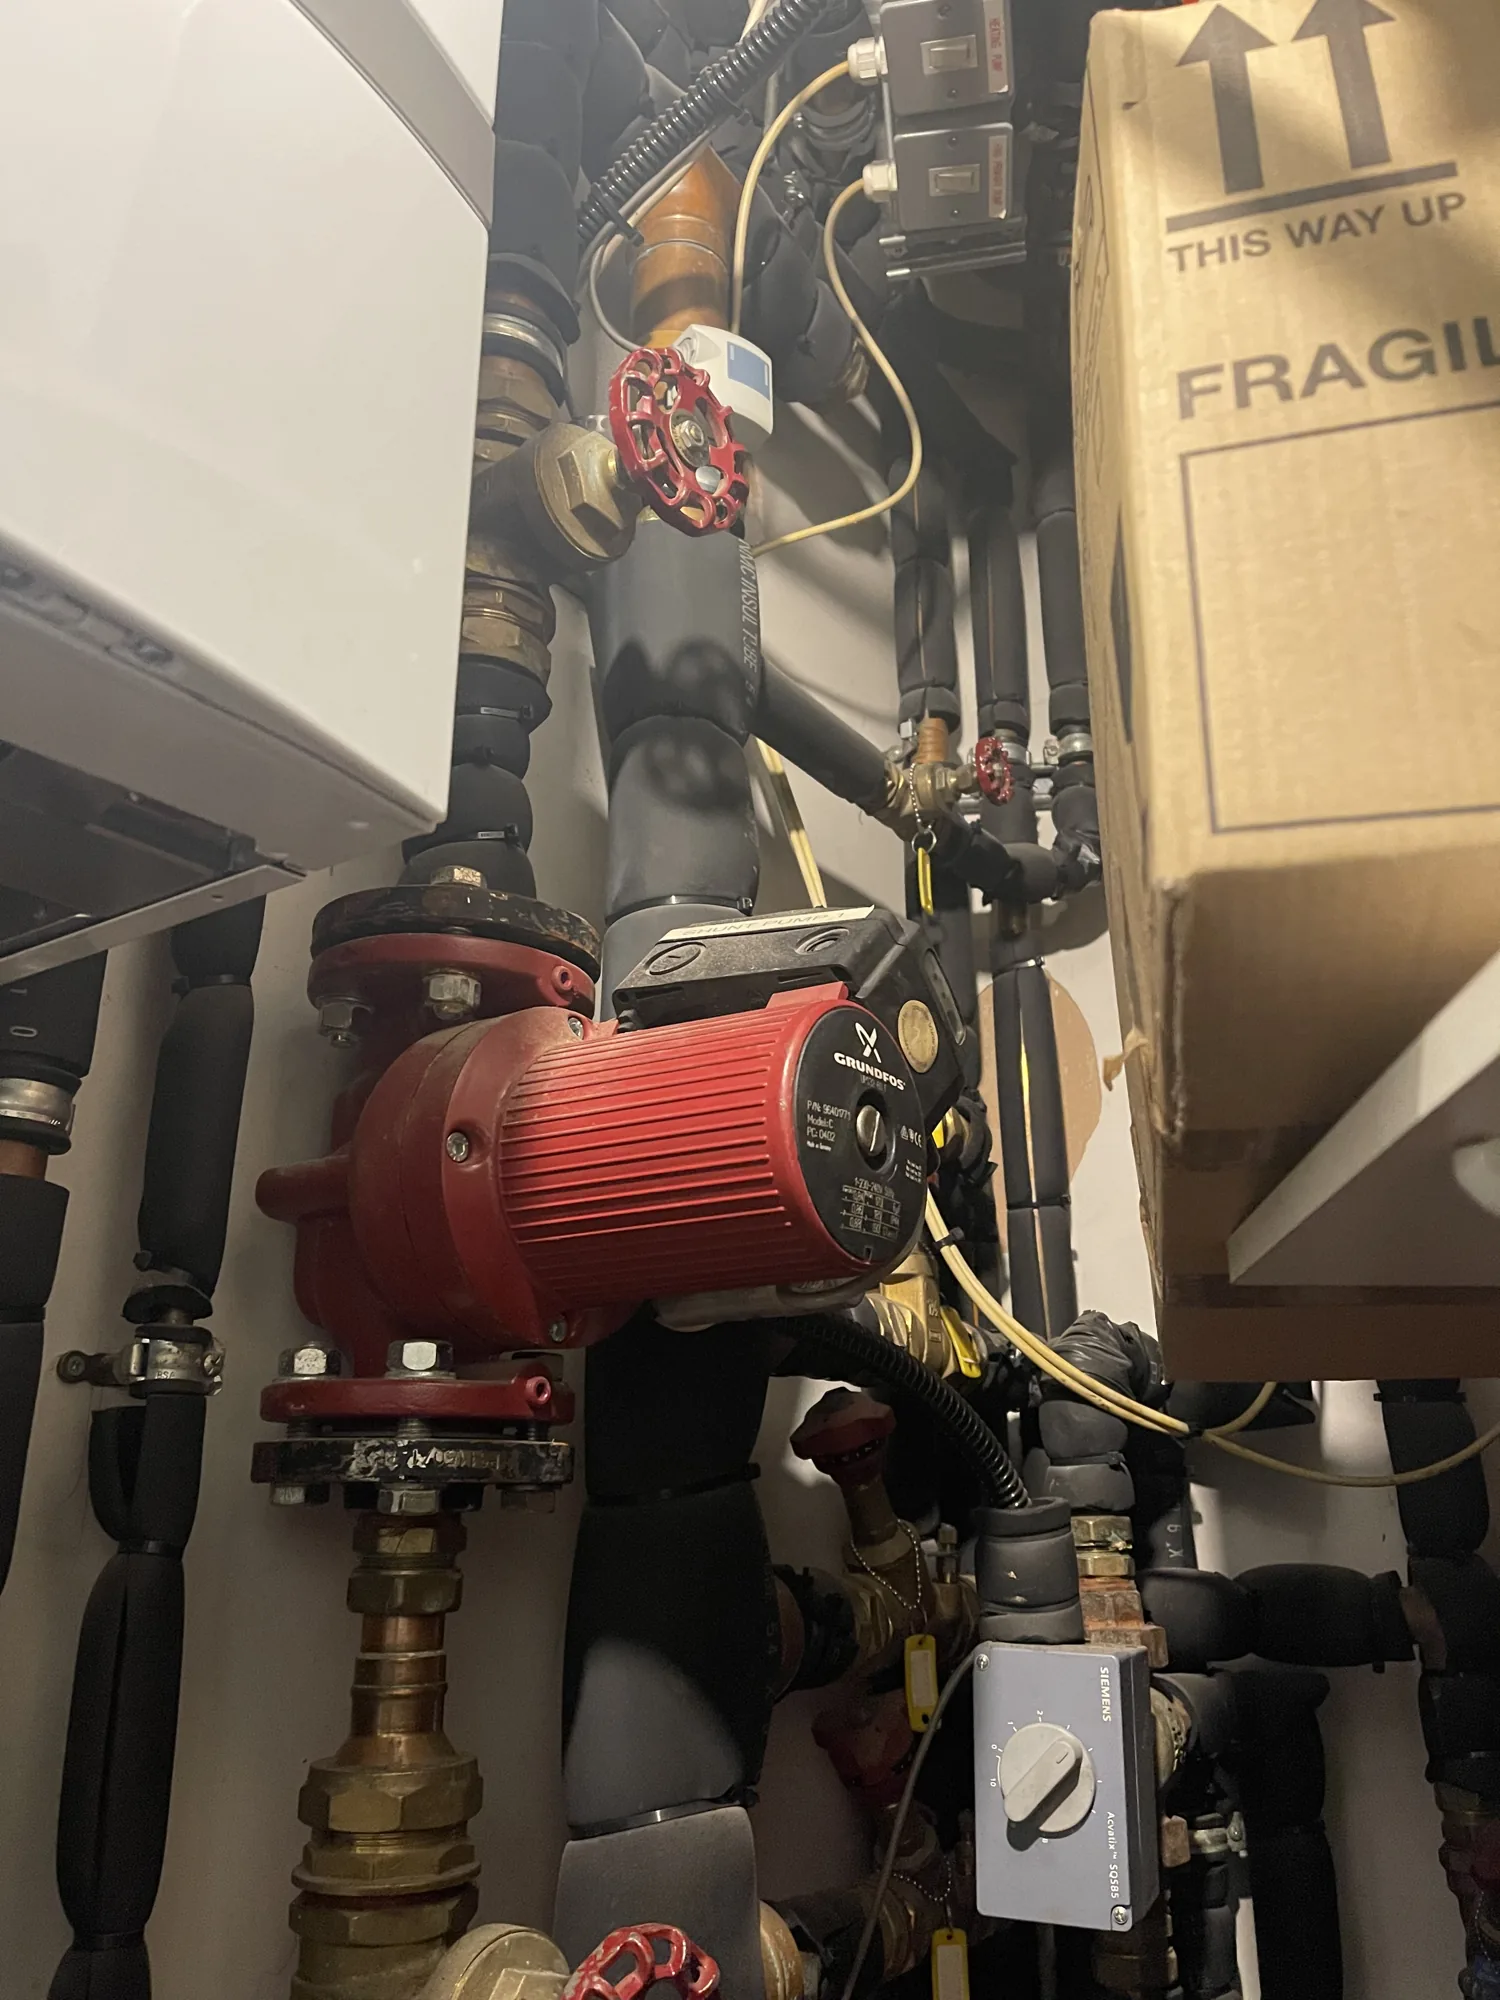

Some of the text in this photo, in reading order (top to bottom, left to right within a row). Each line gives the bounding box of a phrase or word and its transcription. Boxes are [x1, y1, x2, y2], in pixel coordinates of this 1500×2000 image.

[1167, 192, 1465, 272] THIS WAY UP
[833, 1052, 906, 1091] GRUNDFOS
[1100, 1666, 1112, 1722] SIEMENS
